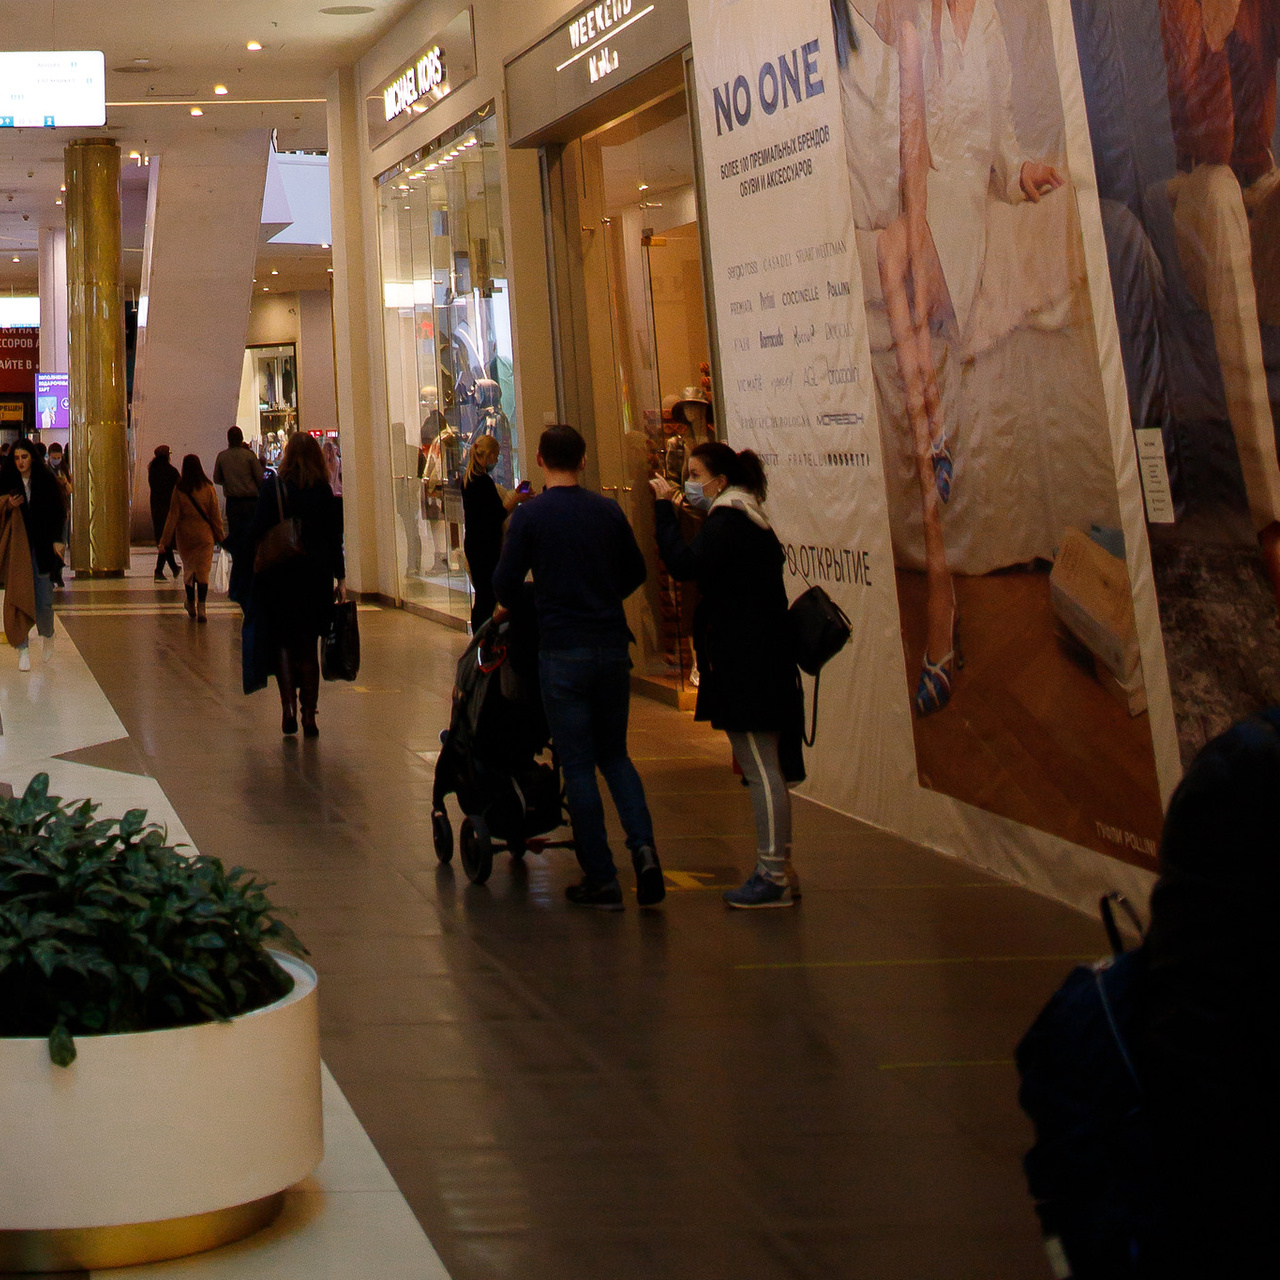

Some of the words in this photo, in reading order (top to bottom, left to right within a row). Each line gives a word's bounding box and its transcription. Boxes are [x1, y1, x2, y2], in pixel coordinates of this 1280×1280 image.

[712, 75, 752, 137] NO
[758, 38, 826, 116] ONE
[721, 159, 740, 180] БОЛЕЕ
[749, 138, 798, 170] ПРЕМИАЛЬНЫХ
[797, 125, 831, 152] БРЕНДОВ
[740, 176, 761, 198] ОБУВИ
[760, 174, 767, 191] И
[766, 158, 813, 189] АКСЕССУАРОВ
[782, 286, 820, 306] COCCINELLE
[799, 544, 872, 587] ОТКРЫТИЕ
